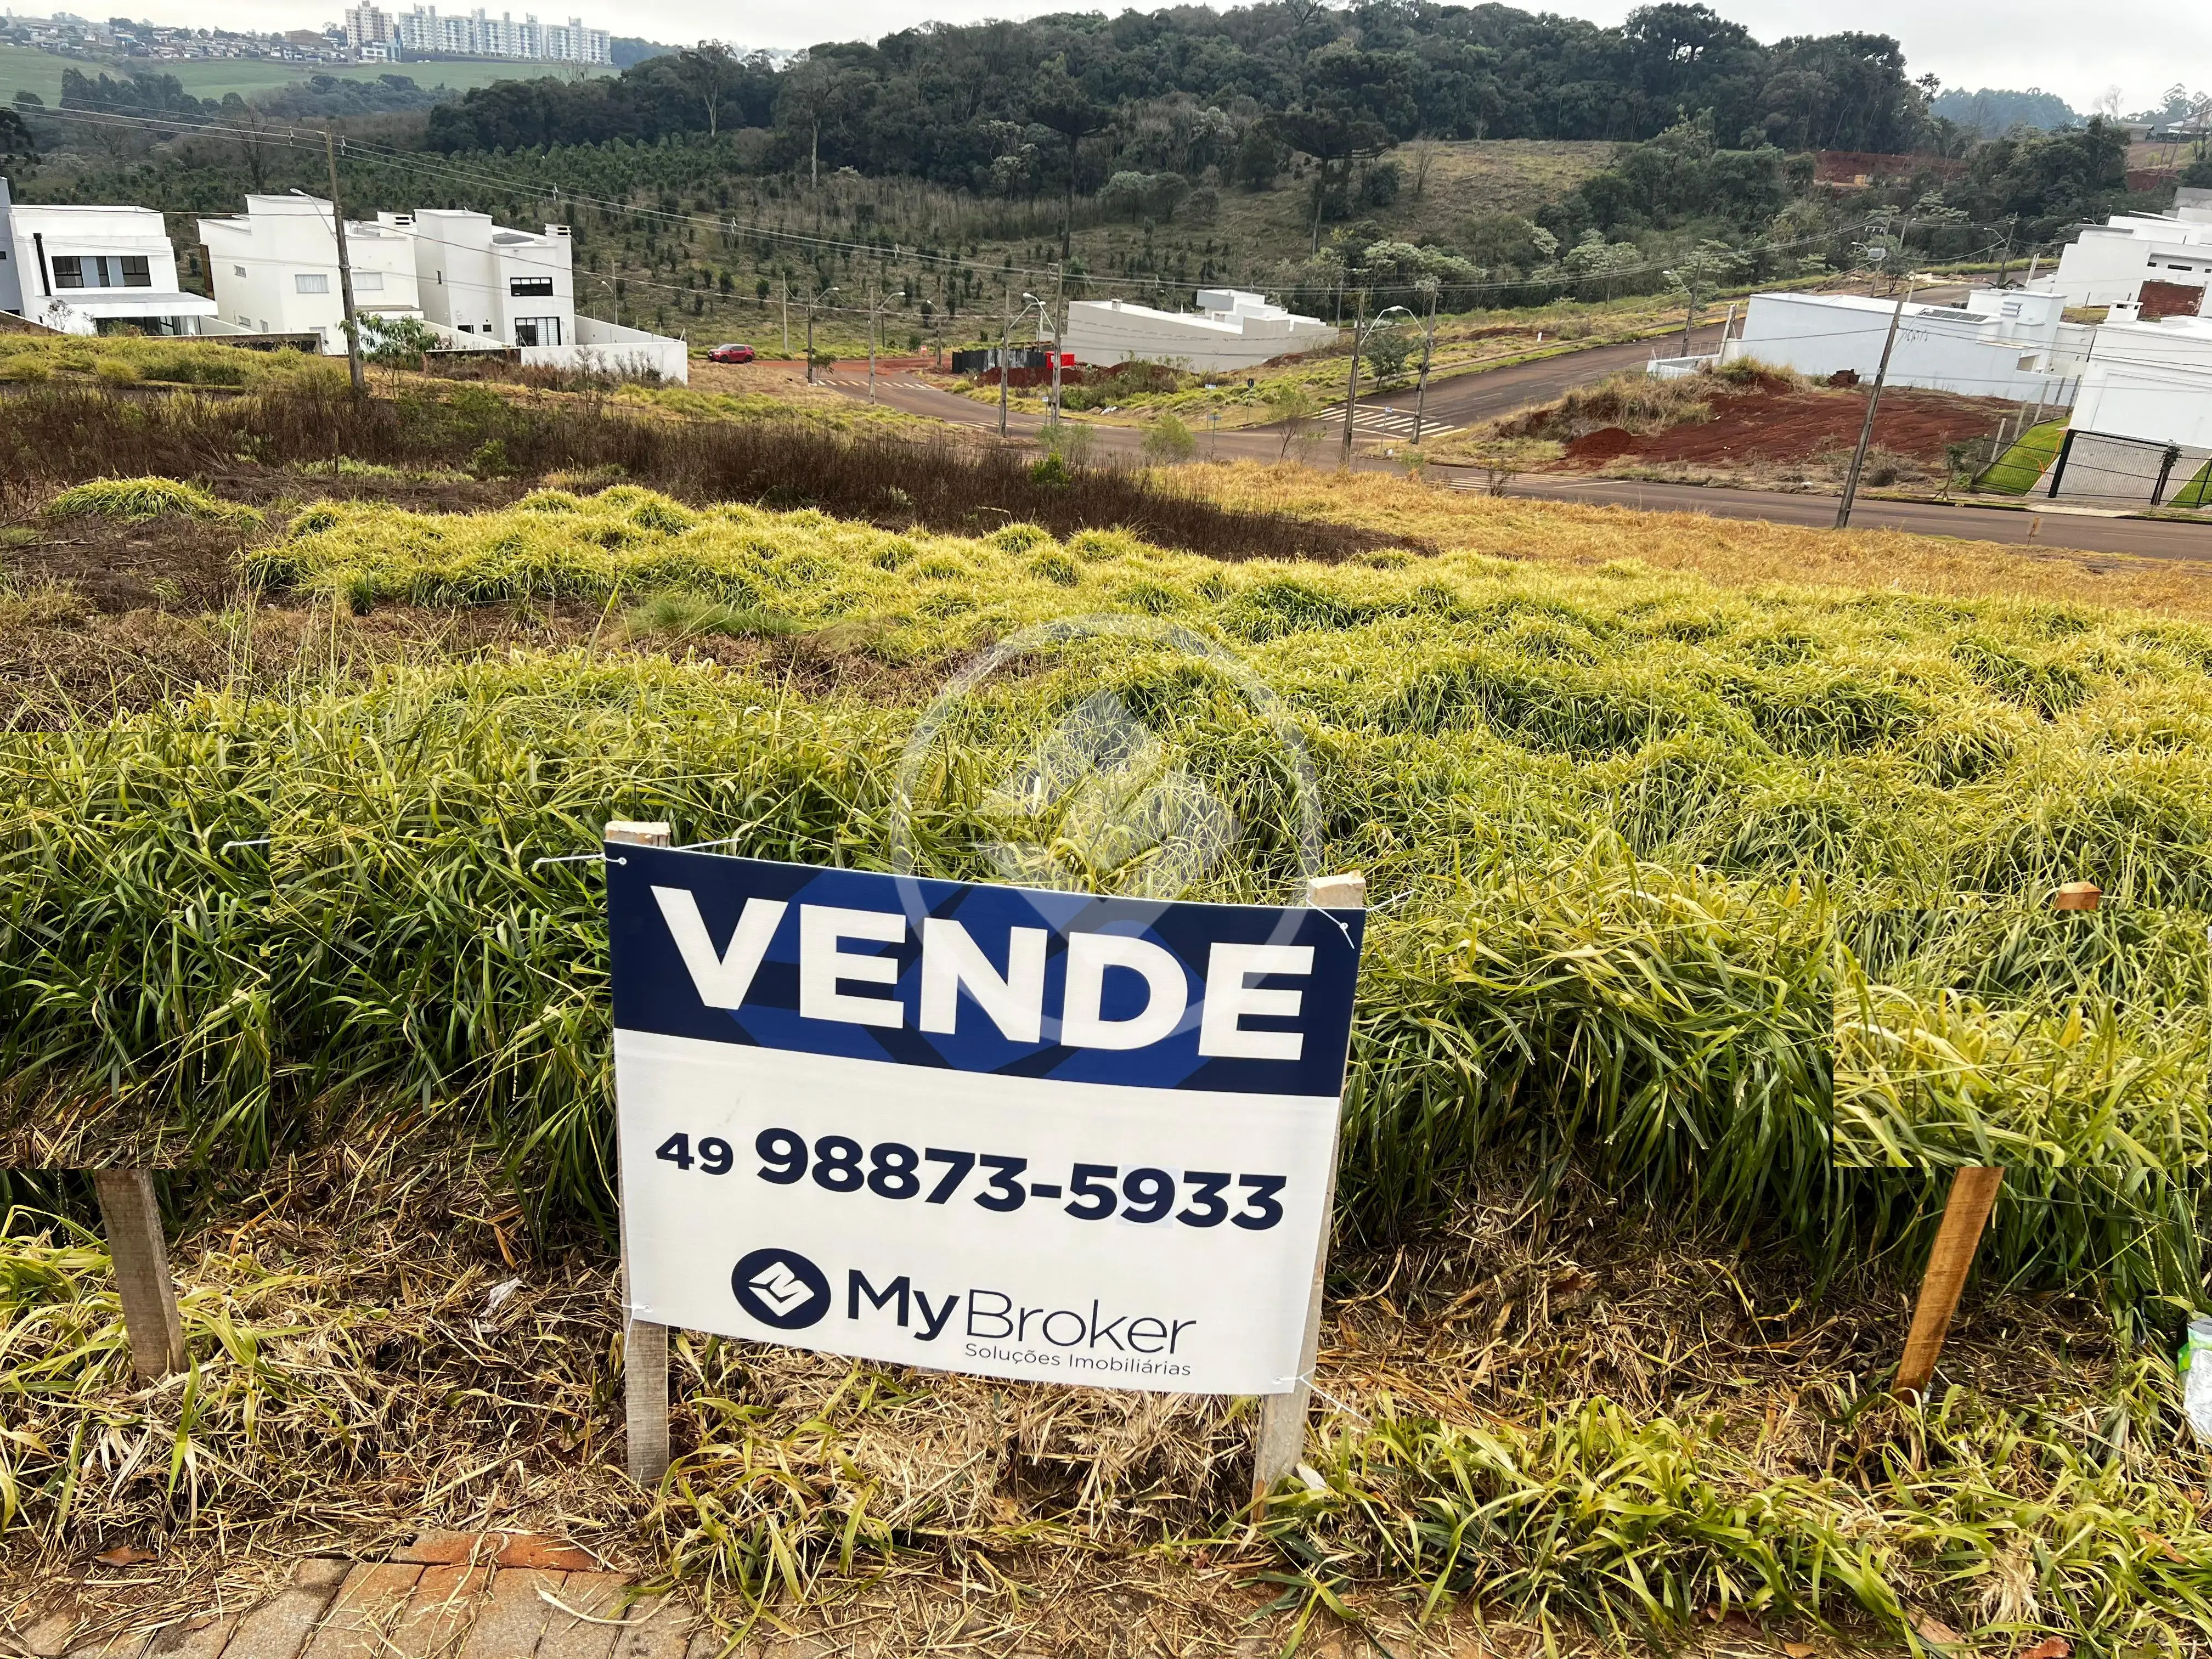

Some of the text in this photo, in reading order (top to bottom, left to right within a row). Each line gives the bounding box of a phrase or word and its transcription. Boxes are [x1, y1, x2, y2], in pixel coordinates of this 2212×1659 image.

[650, 885, 1316, 1060] VENDE
[655, 1127, 1287, 1231] 49 98873-5933
[848, 1268, 1197, 1354] MyBroker
[964, 1342, 1192, 1376] Soluções Imobiliárias
